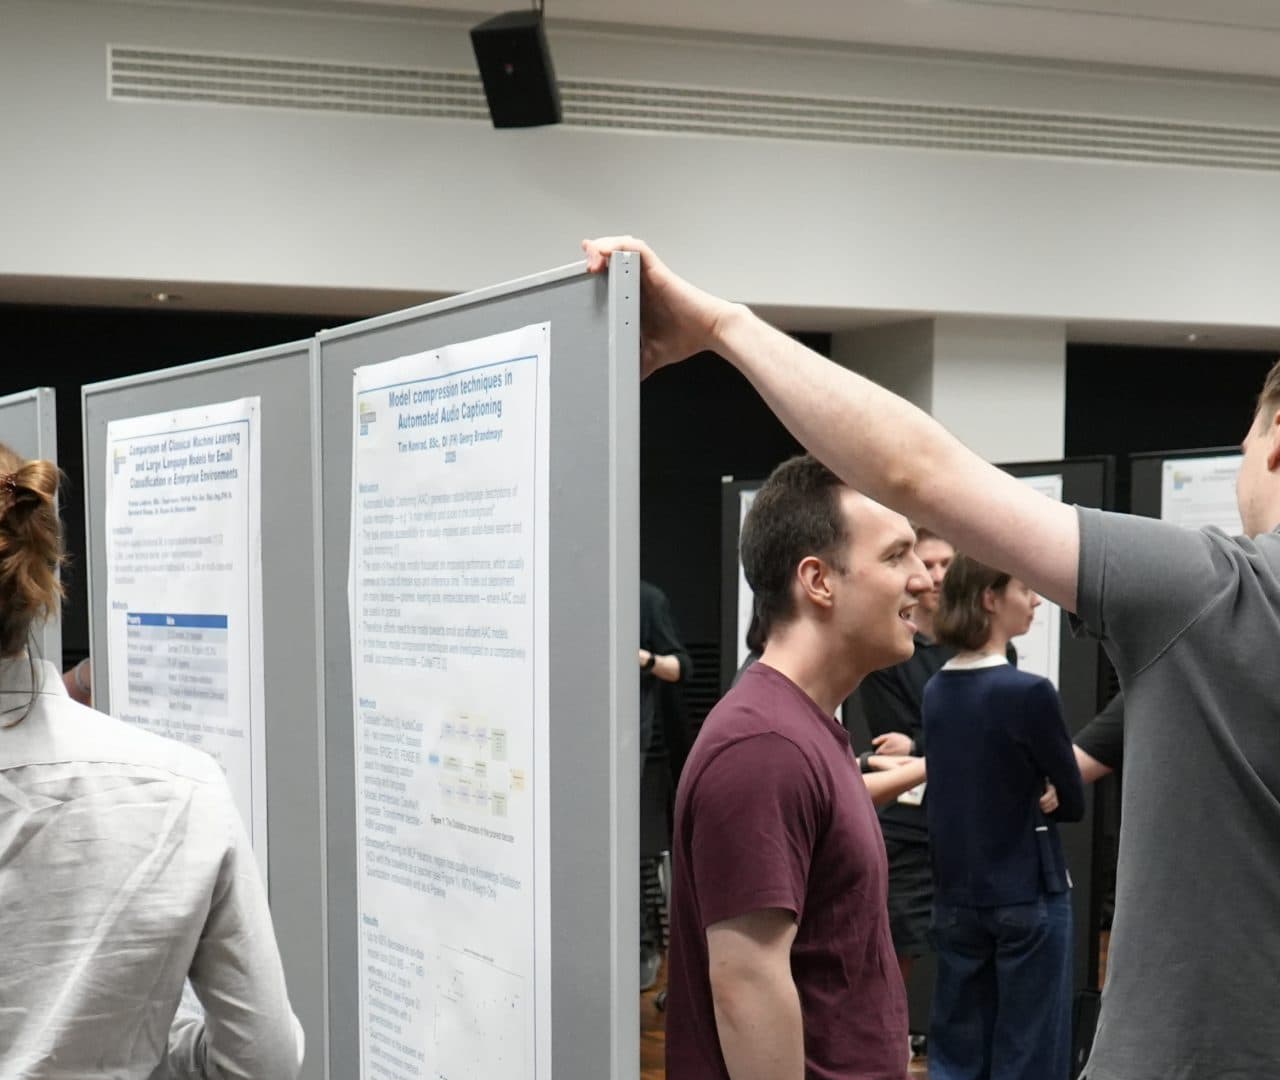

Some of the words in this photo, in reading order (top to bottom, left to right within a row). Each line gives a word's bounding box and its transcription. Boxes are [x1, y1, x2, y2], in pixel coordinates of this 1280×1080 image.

[389, 388, 411, 408] Model
[413, 382, 459, 406] compression
[460, 373, 502, 395] techniques
[504, 368, 513, 386] in
[398, 408, 439, 430] Automated
[440, 404, 460, 424] Audio
[461, 396, 503, 419] Captioning
[216, 431, 241, 446] Learning
[135, 460, 145, 473] and
[146, 458, 161, 474] Large
[216, 448, 233, 462] Email
[130, 473, 167, 489] Classification
[174, 470, 199, 487] Enterprise
[200, 467, 239, 482] Environments
